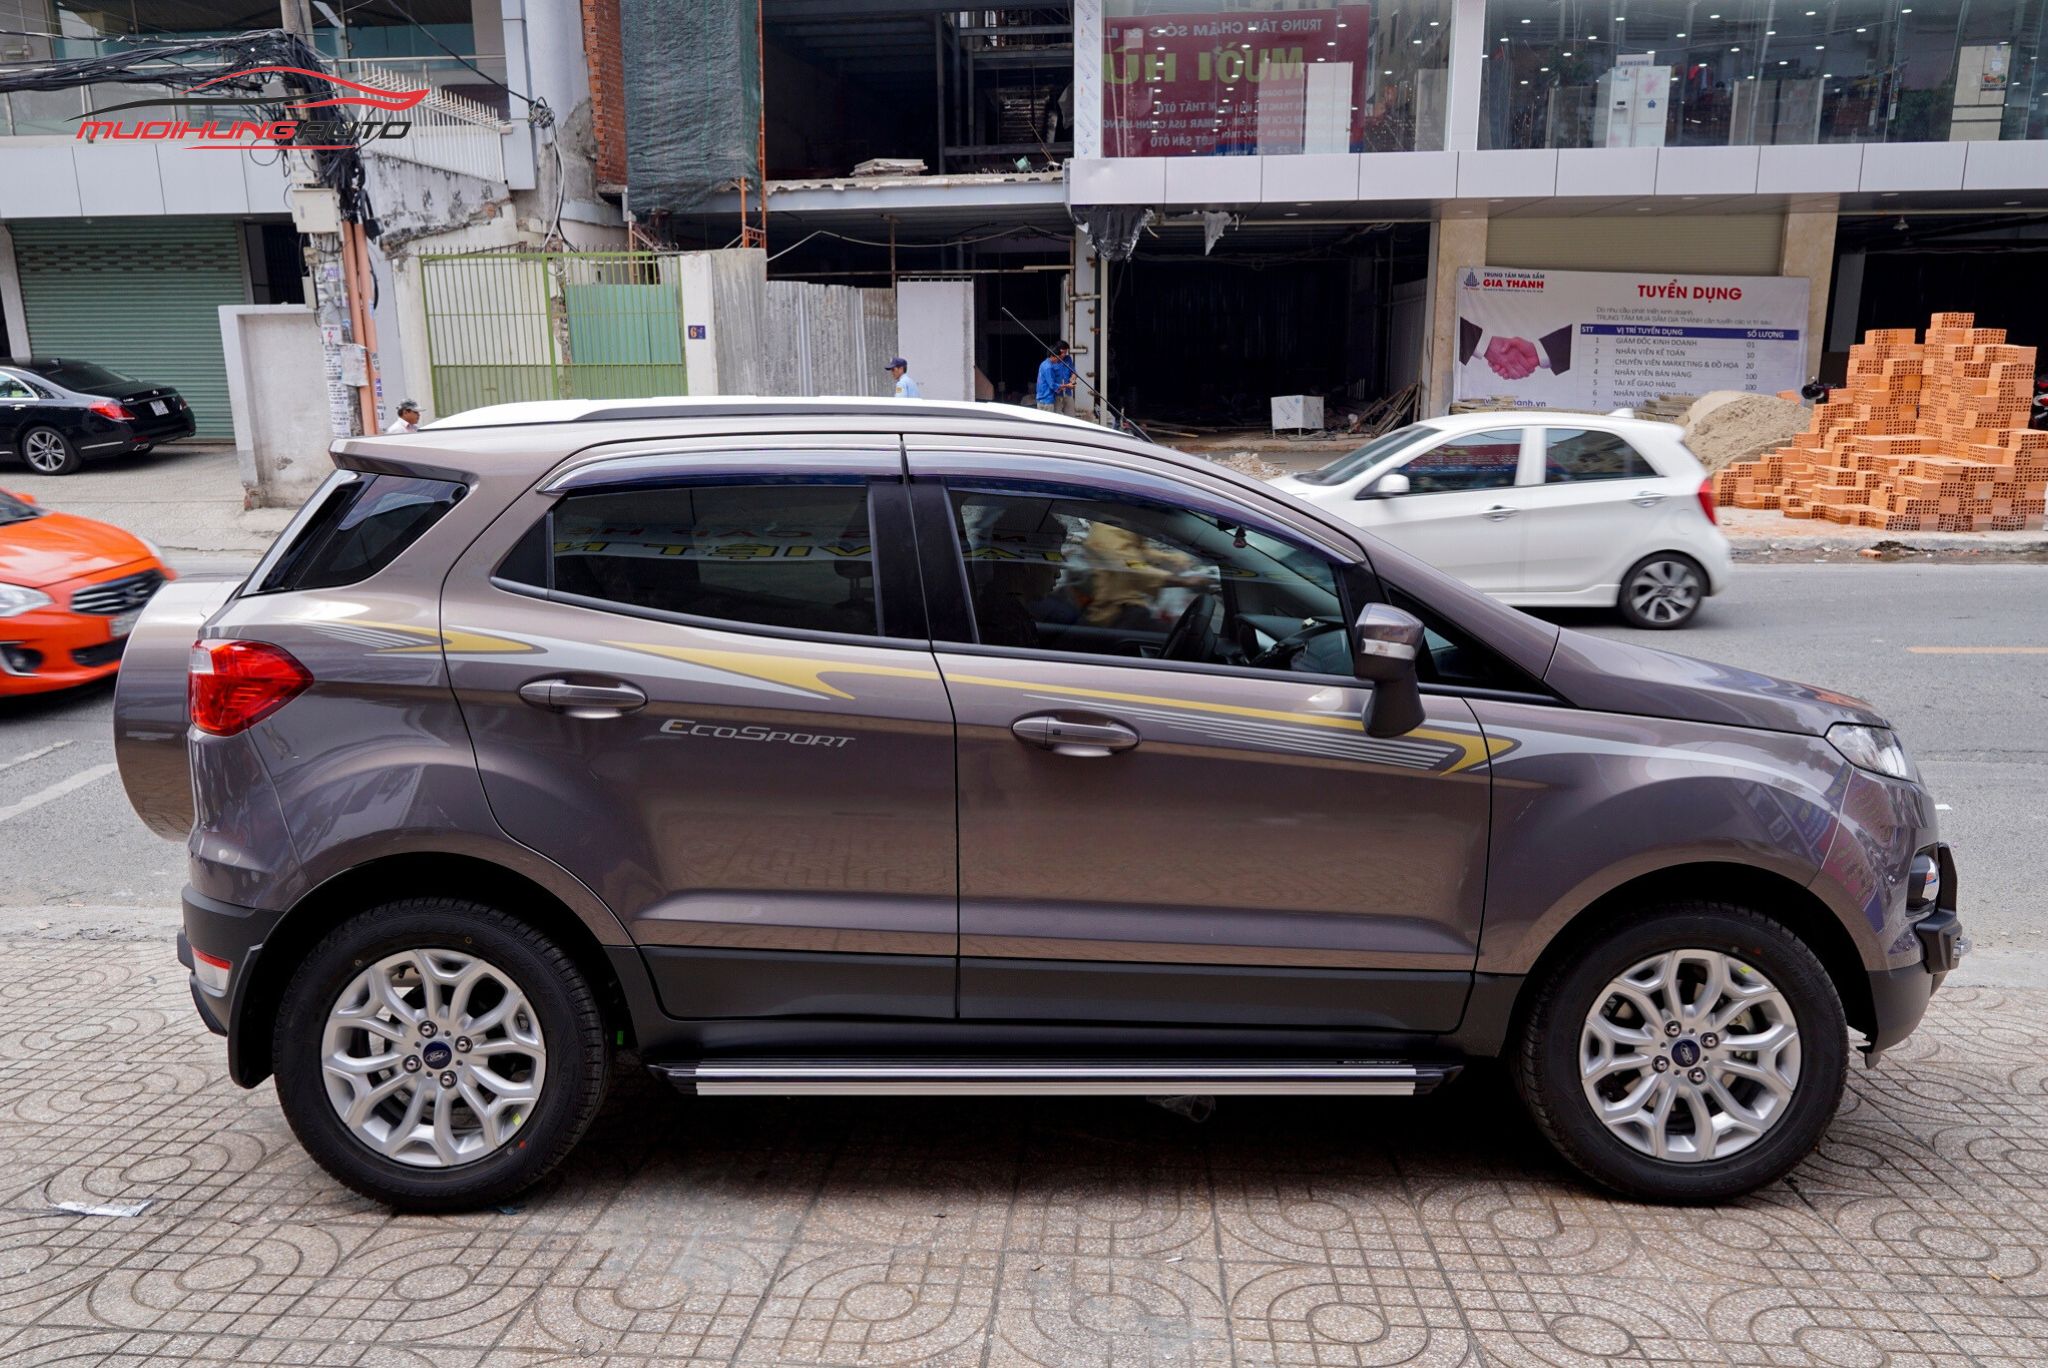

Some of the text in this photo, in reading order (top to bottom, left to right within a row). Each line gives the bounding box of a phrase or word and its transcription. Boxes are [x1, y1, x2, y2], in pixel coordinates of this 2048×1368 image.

[1483, 278, 1503, 288] GIA
[1638, 279, 1742, 304] TUYỂN DỤNG
[1652, 338, 1670, 346] KINH
[1671, 338, 1698, 347] DOANH
[1662, 360, 1703, 369] MARKETING
[1636, 380, 1655, 388] GIAO
